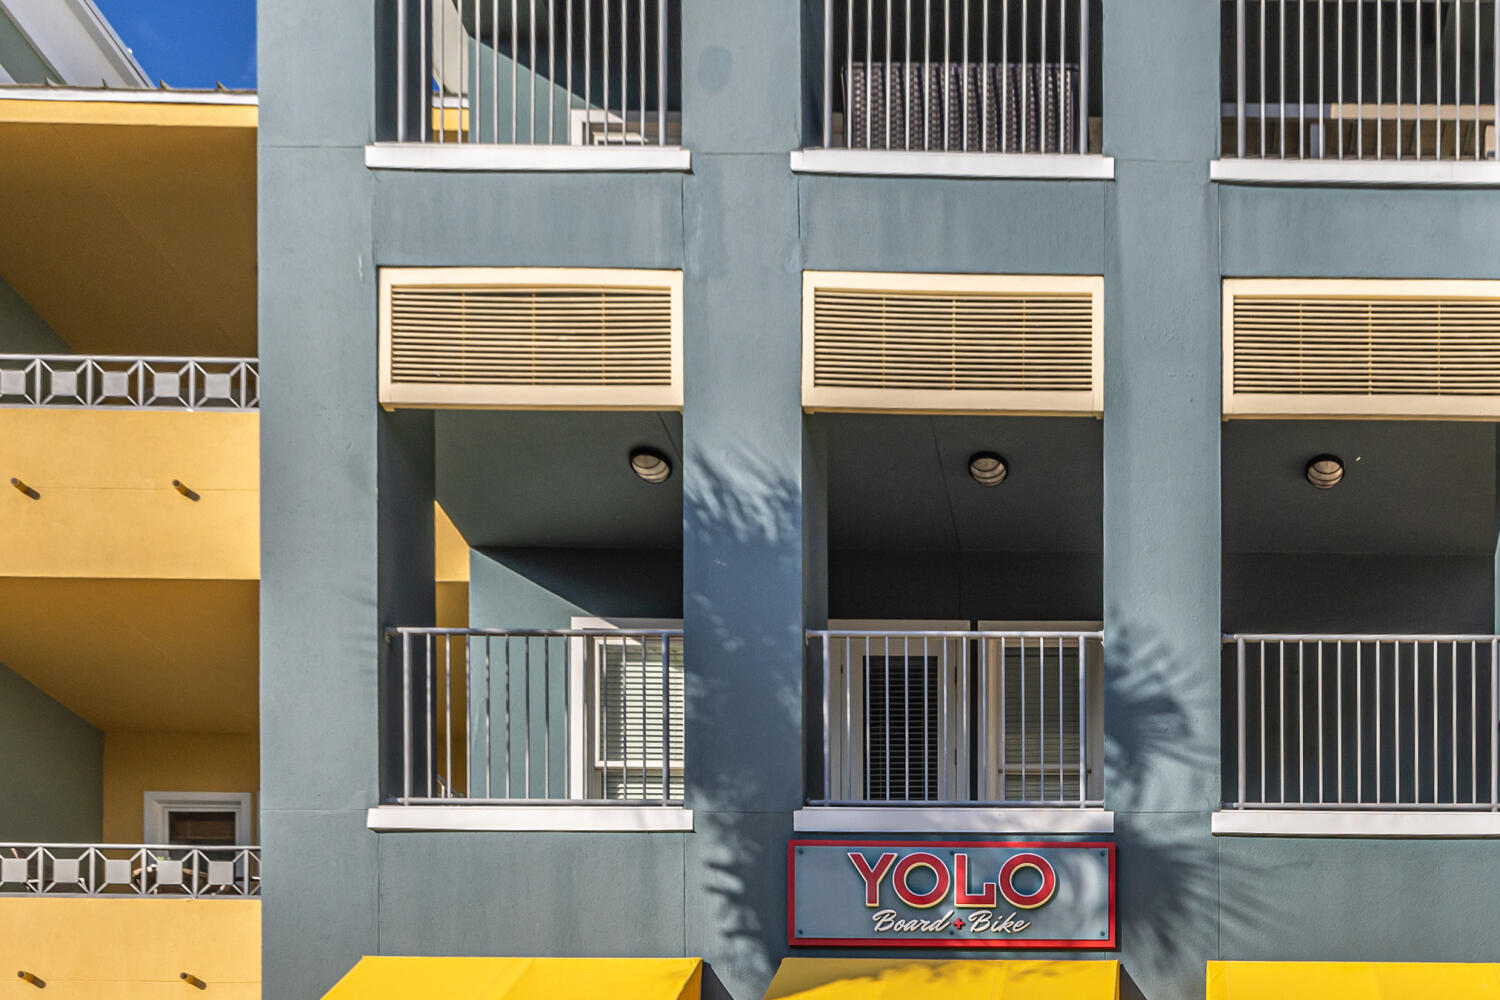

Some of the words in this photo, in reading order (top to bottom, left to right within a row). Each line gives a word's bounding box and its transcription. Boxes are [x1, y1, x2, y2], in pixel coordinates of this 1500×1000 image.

[847, 852, 1057, 910] YOLO
[872, 908, 955, 934] Board
[968, 909, 1031, 934] Bike
